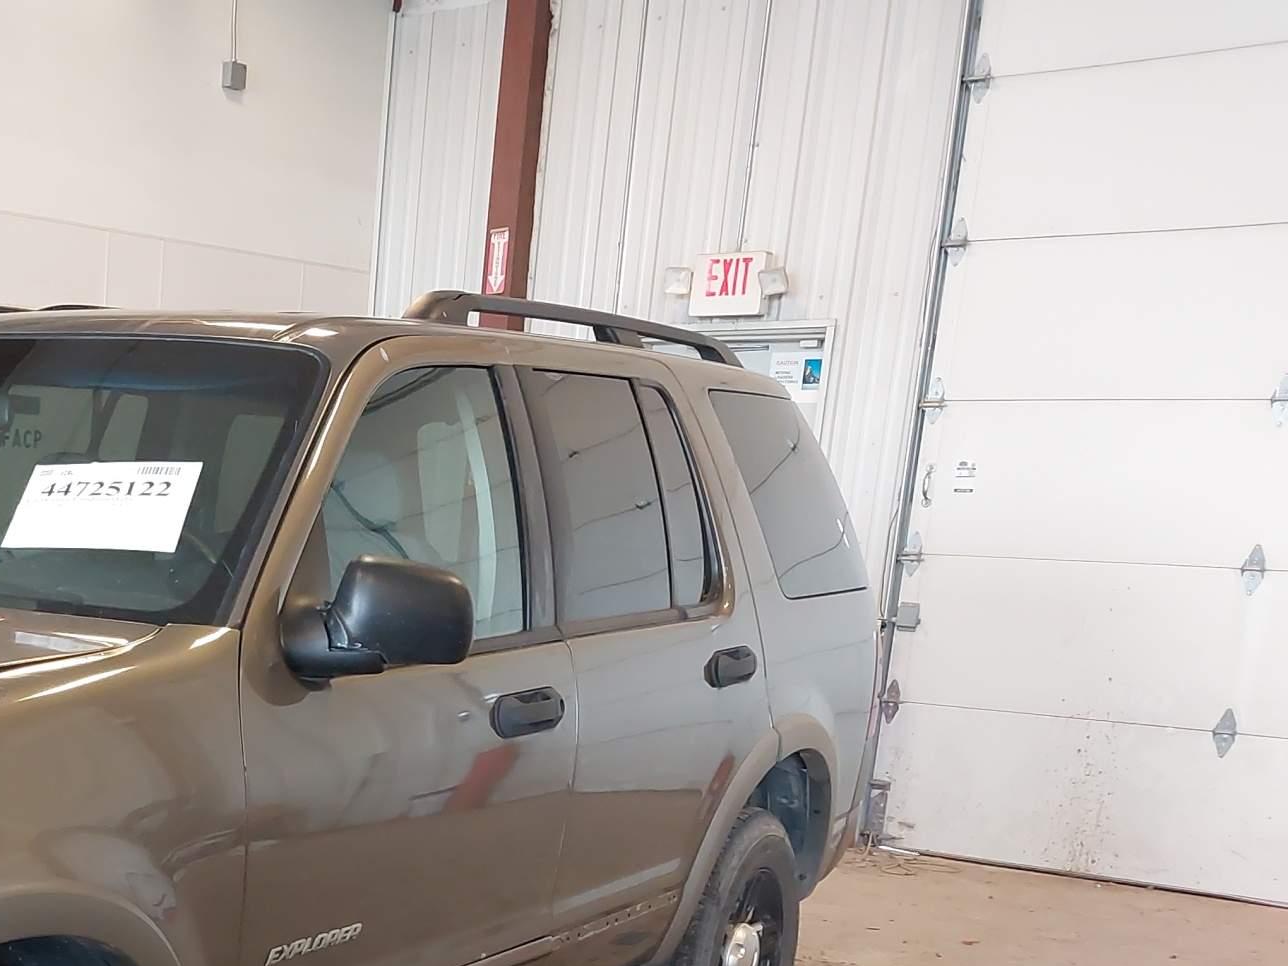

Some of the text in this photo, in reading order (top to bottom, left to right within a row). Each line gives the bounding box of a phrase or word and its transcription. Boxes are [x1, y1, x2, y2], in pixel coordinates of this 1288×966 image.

[705, 257, 753, 296] EXIT
[40, 481, 172, 497] 44725122
[265, 923, 362, 966] EXPLORER
